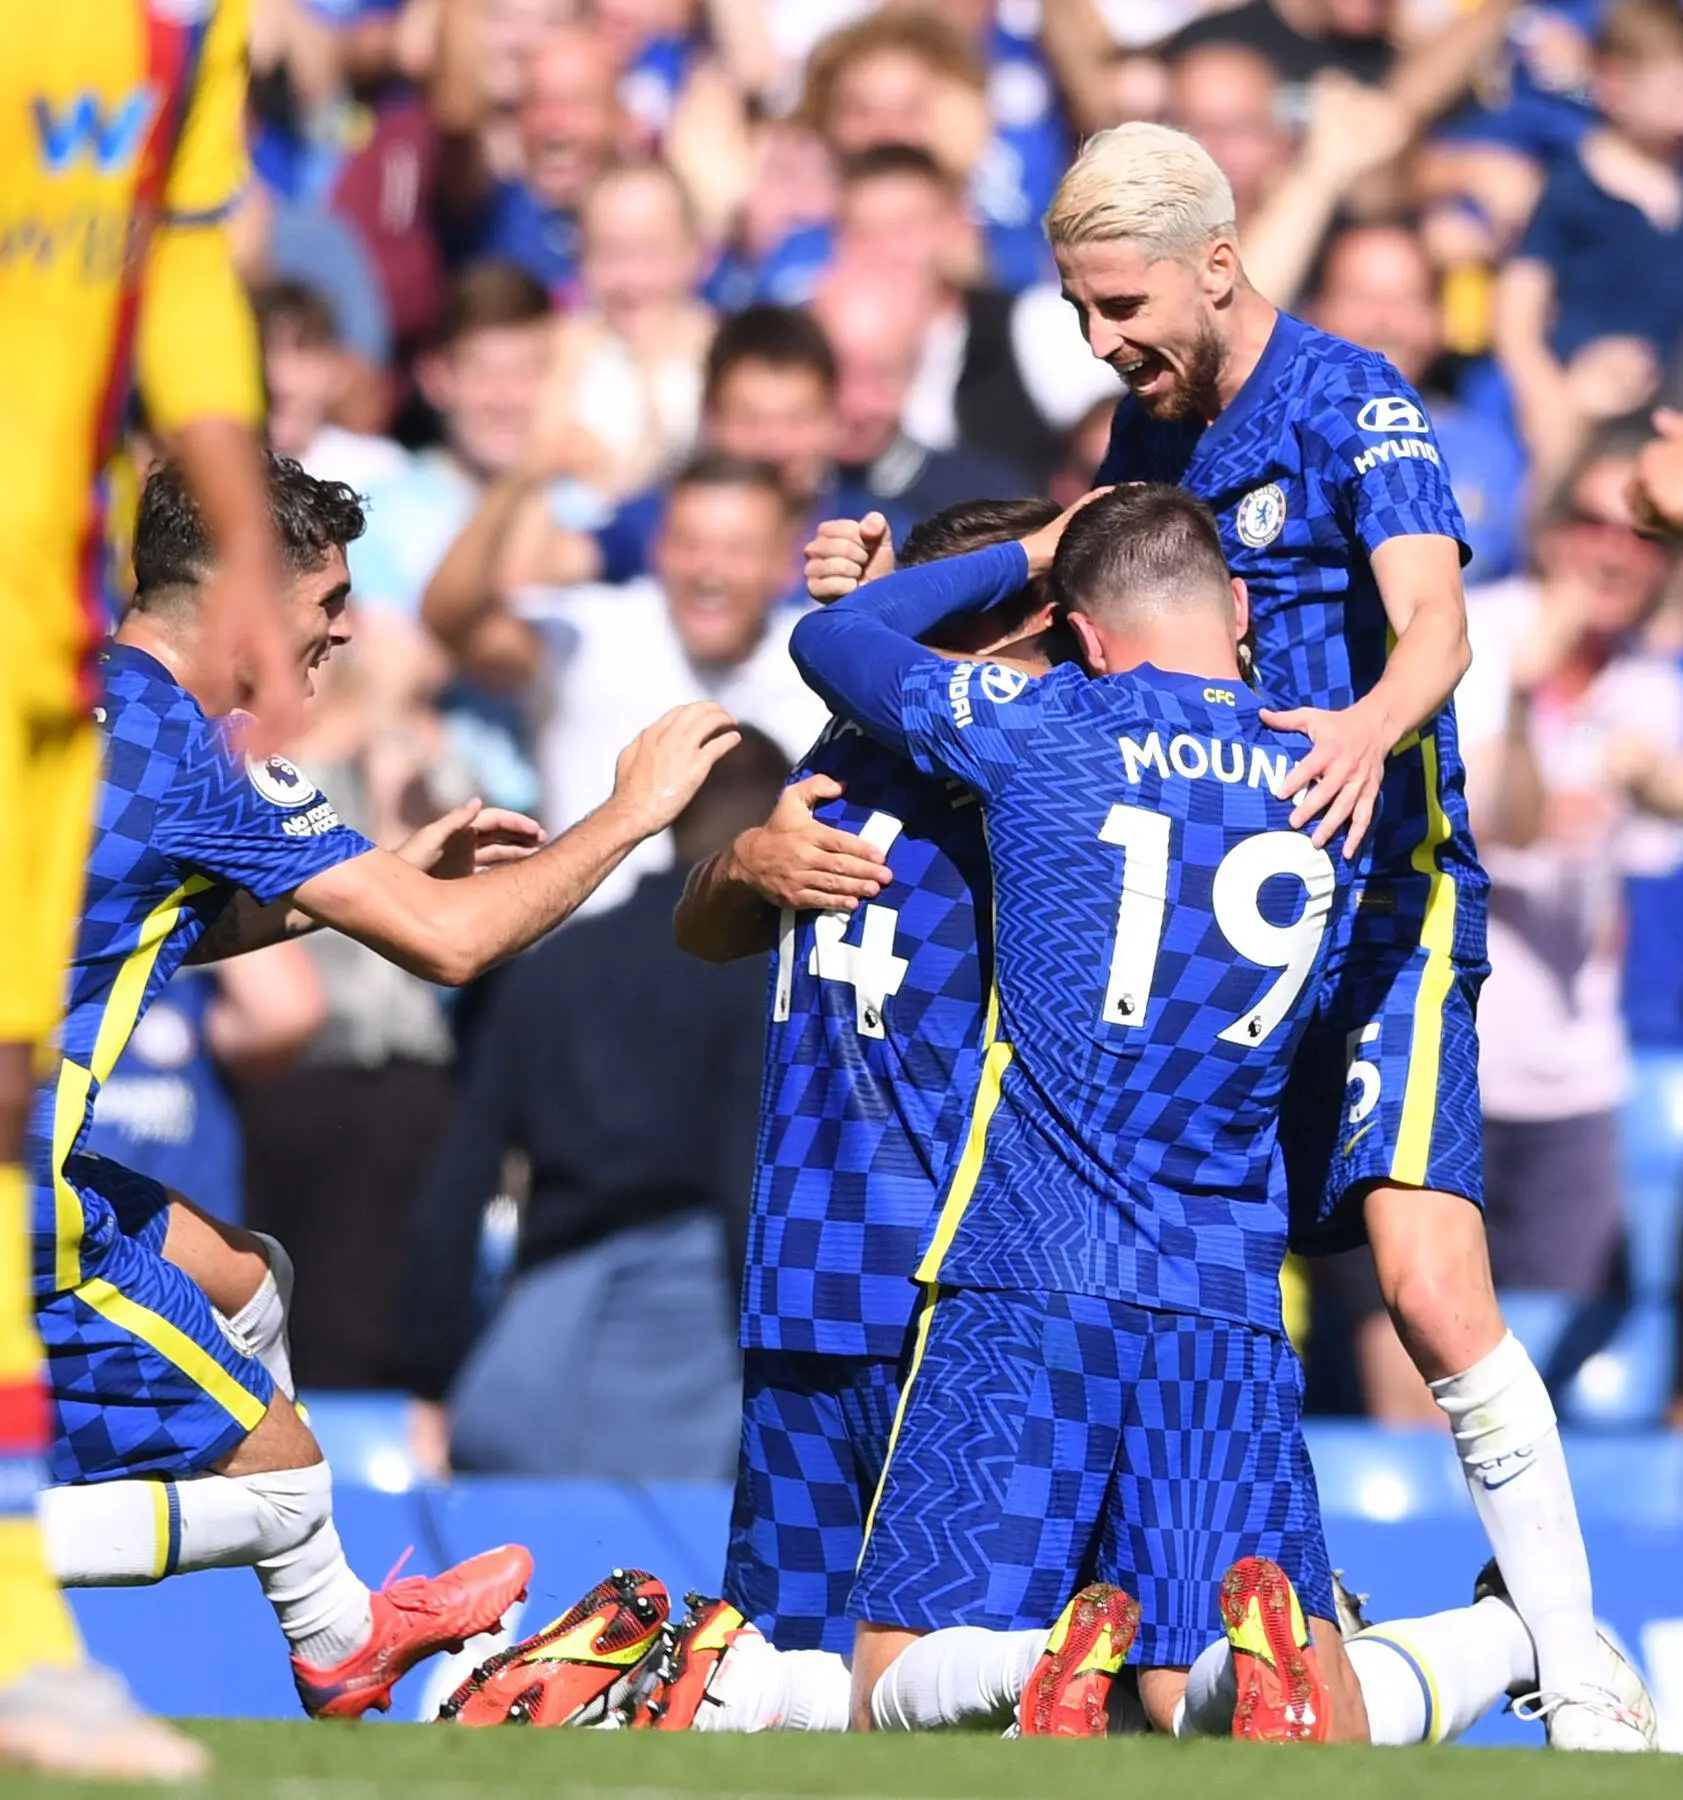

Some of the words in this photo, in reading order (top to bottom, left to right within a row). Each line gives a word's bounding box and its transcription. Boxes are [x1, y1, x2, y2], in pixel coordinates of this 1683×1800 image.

[1203, 688, 1236, 706] CFC
[281, 815, 309, 836] No
[773, 811, 910, 1041] 14
[1097, 803, 1336, 1048] 19
[1346, 1022, 1381, 1124] 5
